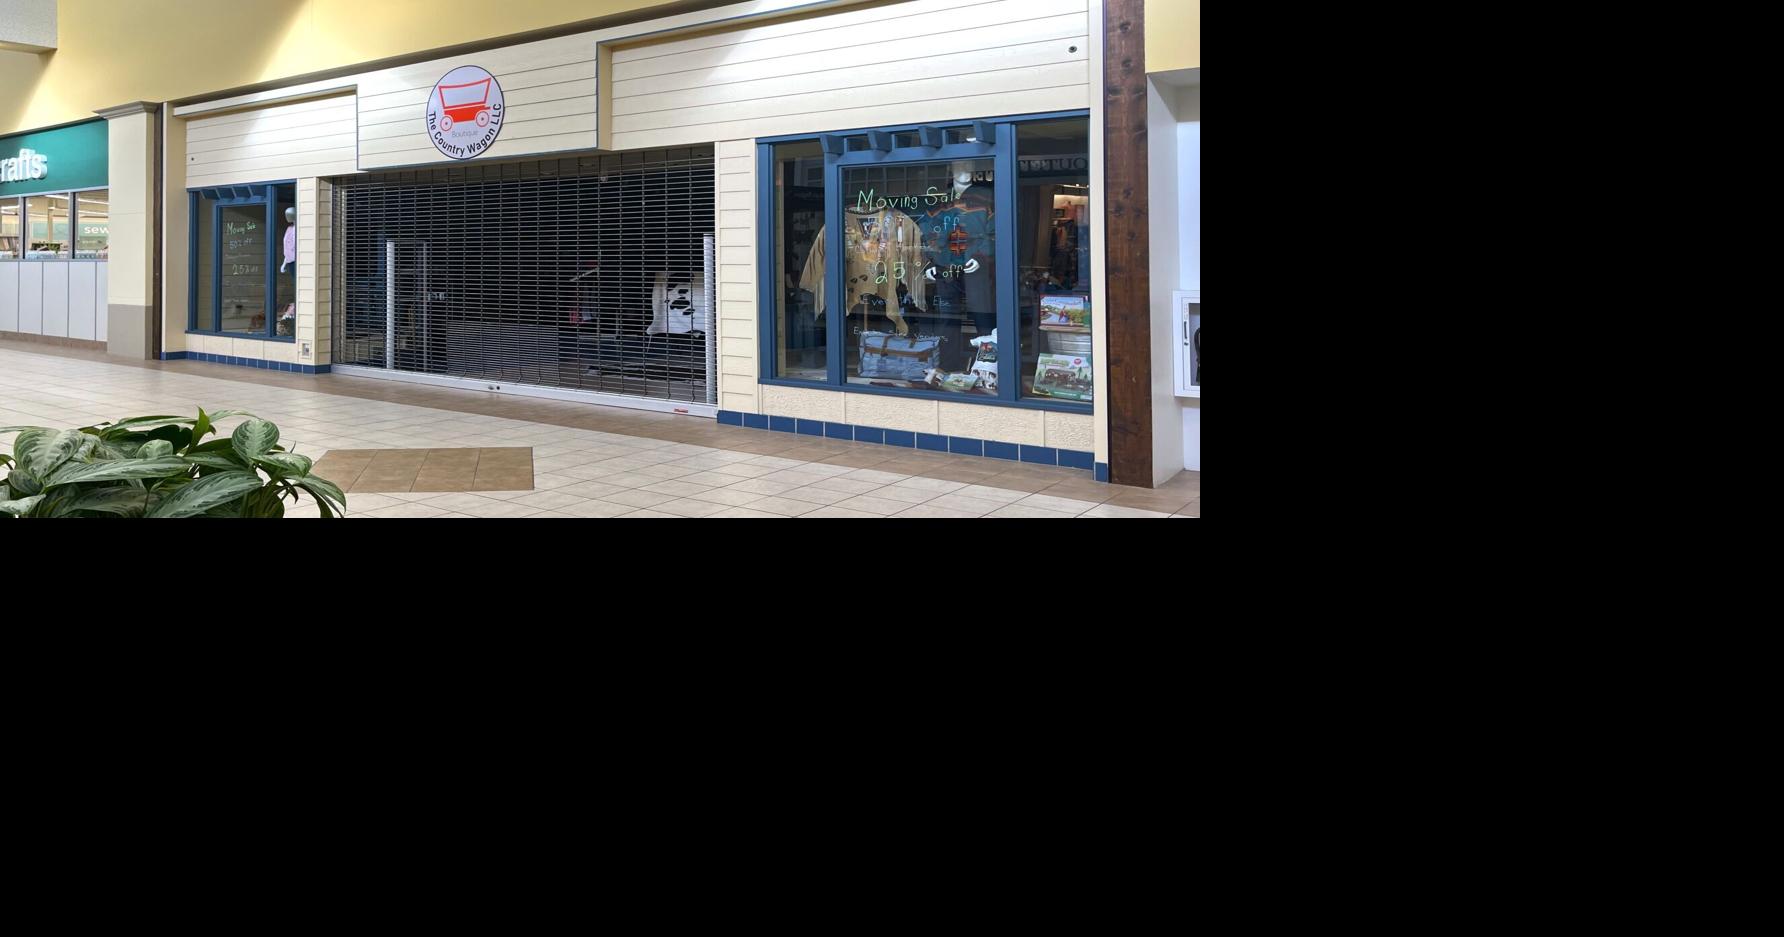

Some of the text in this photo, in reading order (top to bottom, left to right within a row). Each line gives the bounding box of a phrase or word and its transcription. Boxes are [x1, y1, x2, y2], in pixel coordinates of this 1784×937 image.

[428, 103, 502, 158] The Country Wagon LLC
[0, 148, 48, 182] rafts
[856, 186, 961, 211] Moving Sale
[933, 215, 961, 234] off
[942, 264, 964, 280] off
